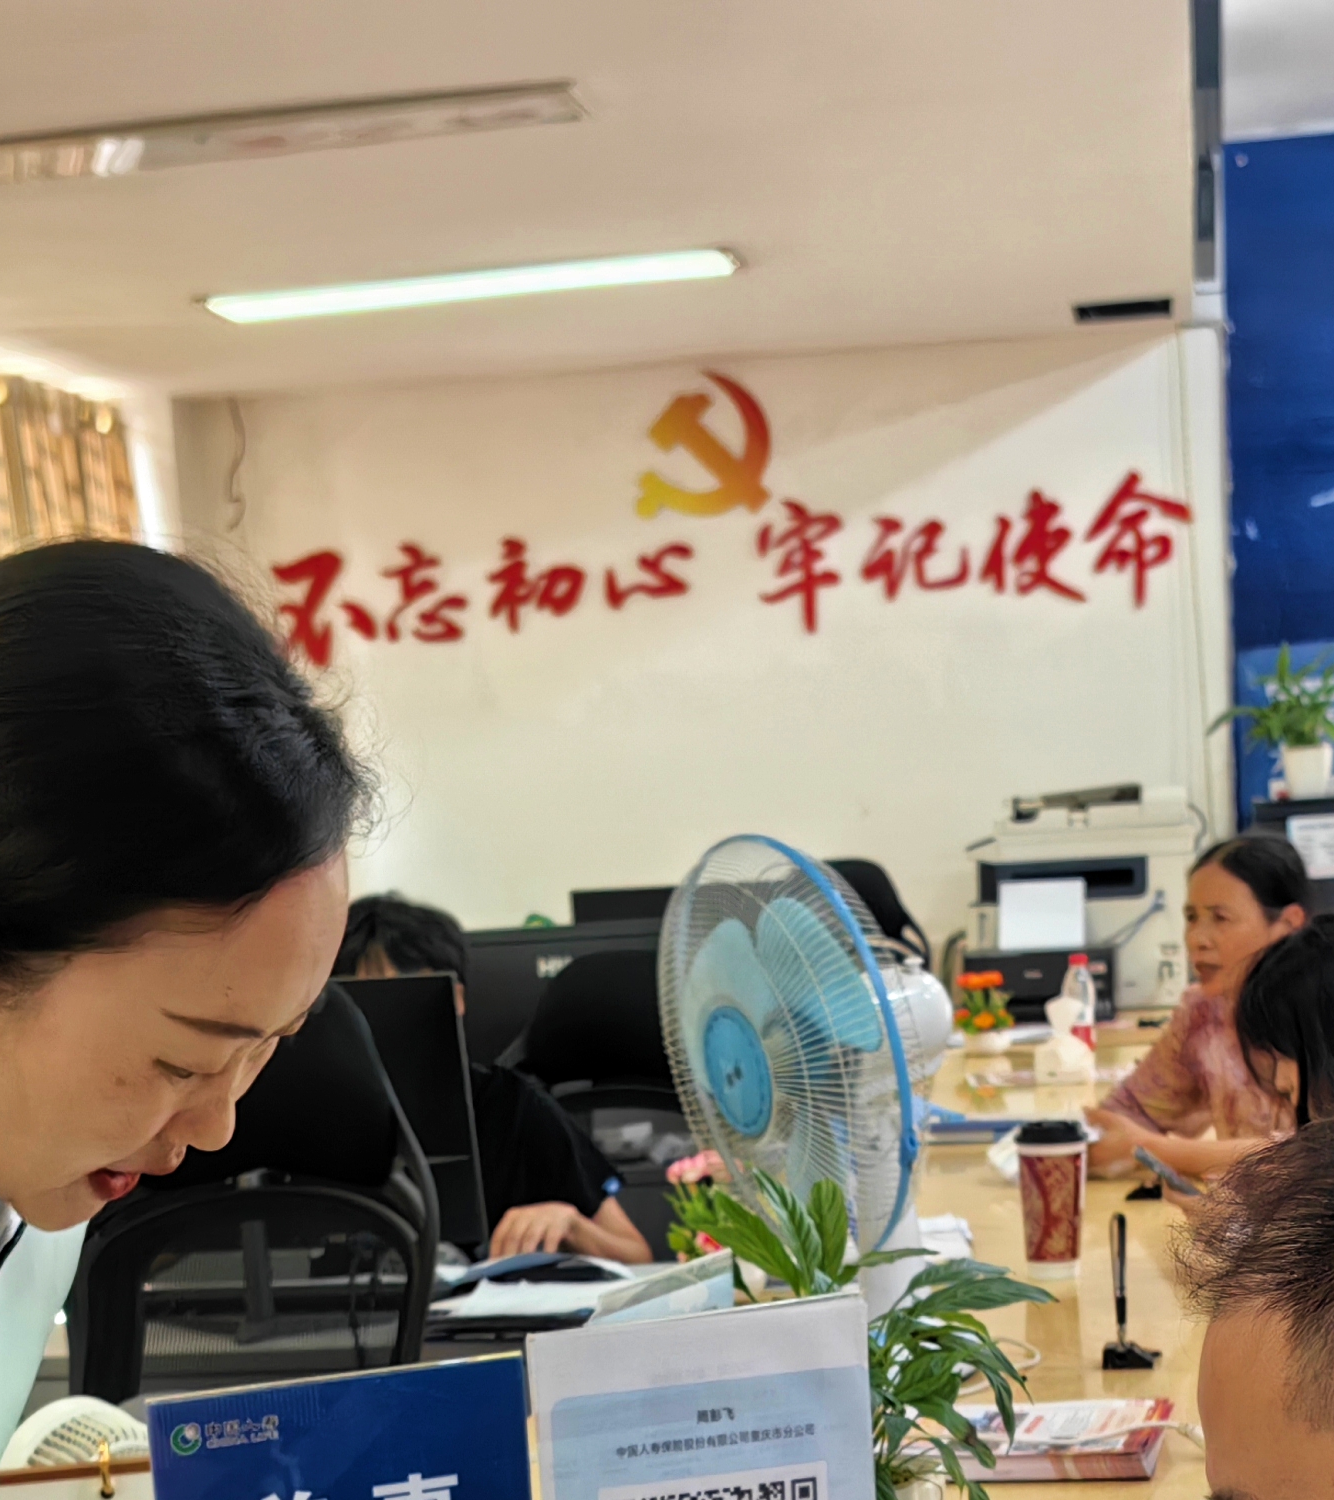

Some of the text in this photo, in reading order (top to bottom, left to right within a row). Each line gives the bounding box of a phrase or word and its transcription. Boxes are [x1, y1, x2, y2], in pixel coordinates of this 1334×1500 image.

[272, 472, 1191, 668] 不忘初心 牢记使命
